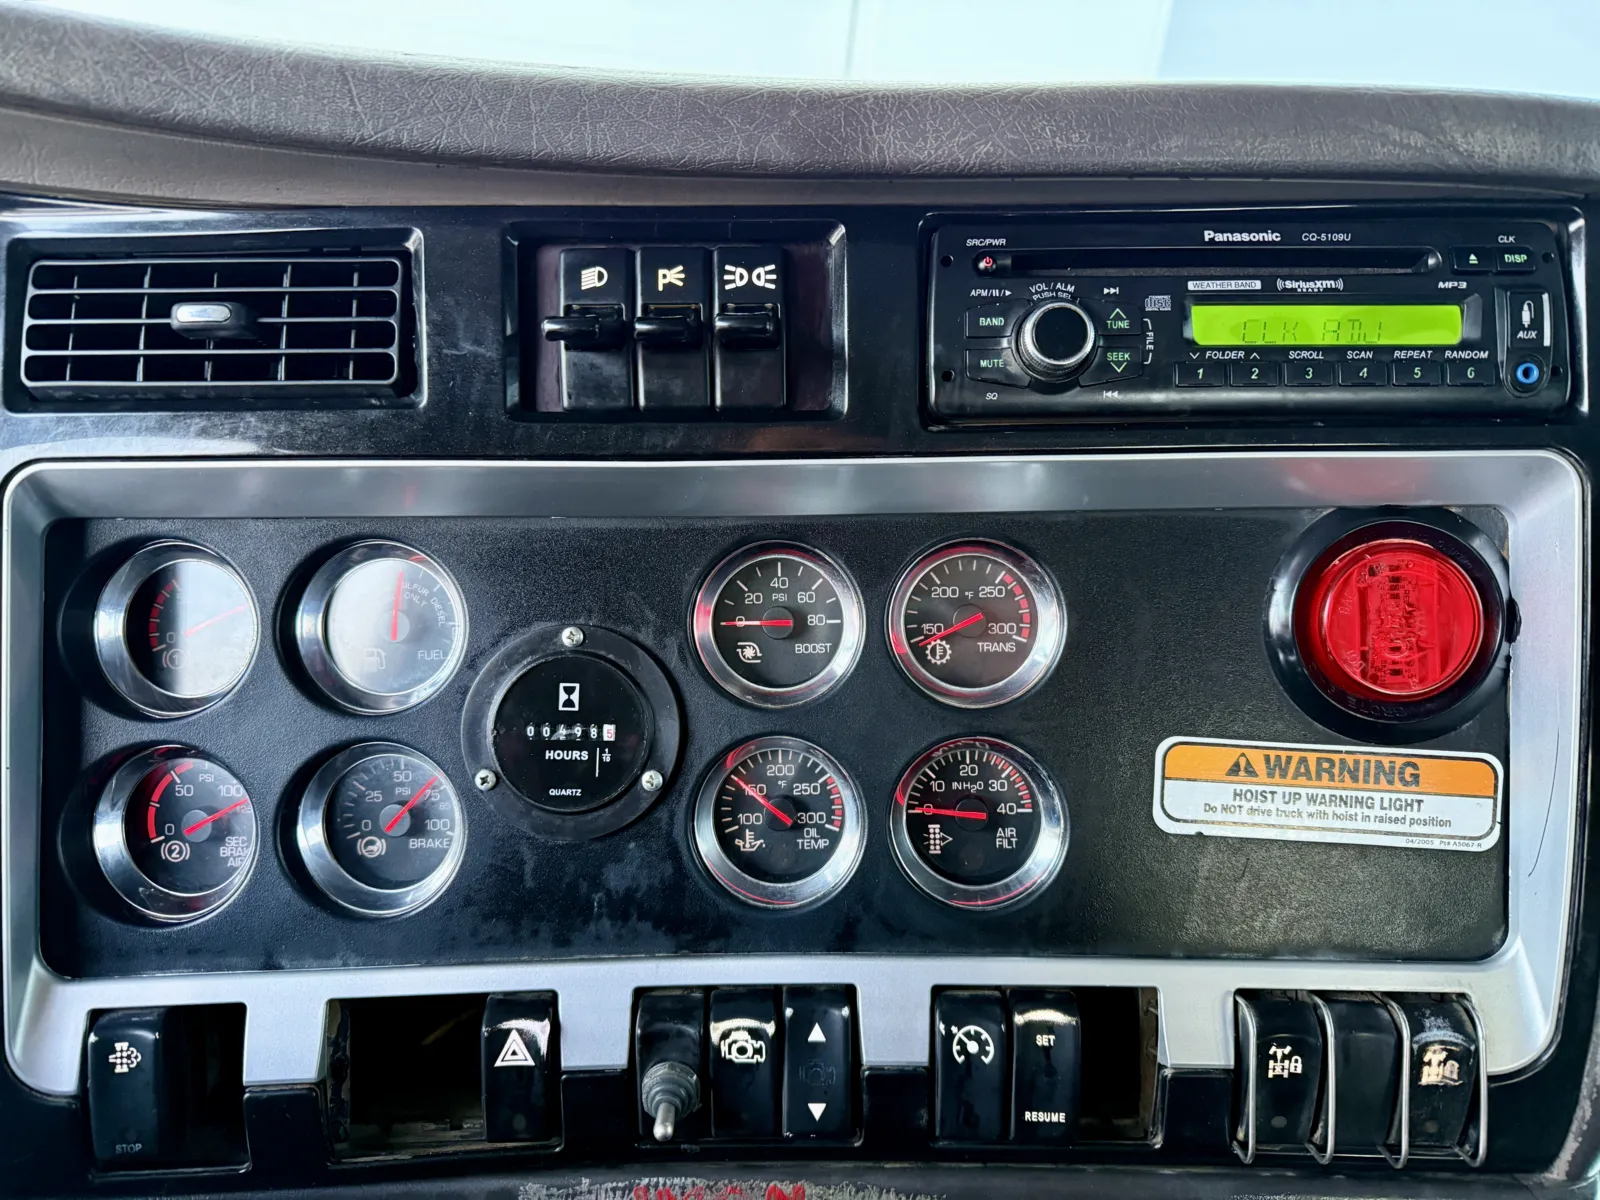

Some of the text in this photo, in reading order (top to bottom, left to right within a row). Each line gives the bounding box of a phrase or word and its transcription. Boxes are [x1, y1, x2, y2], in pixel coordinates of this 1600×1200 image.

[1203, 230, 1281, 242] Panasonic
[1301, 233, 1351, 242] CQ-5109U
[1498, 235, 1515, 244] CLK
[966, 238, 1006, 247] SRC/PWR
[1504, 254, 1527, 264] DISP
[1029, 282, 1048, 293] VOL
[1056, 282, 1075, 293] ALM
[1192, 281, 1257, 289] WEATHER BAND
[1438, 281, 1467, 289] MP3
[1032, 291, 1072, 301] PUSH SEL
[979, 316, 1005, 326] BAND
[1106, 320, 1130, 329] TUNE
[1516, 330, 1537, 339] AUX
[1146, 332, 1154, 350] FILE
[1106, 352, 1131, 361] SEEK
[1205, 351, 1245, 360] FOLDER
[1288, 351, 1324, 360] SCROLL
[1346, 350, 1373, 360] SCAN
[1393, 350, 1433, 360] REPEAT
[1444, 350, 1489, 360] RANDOM
[979, 358, 1005, 369] MUTE
[1197, 367, 1203, 379] 1
[1251, 367, 1259, 379] 2
[1305, 367, 1313, 379] 3
[1359, 367, 1368, 379] 4
[1413, 367, 1422, 379] 5
[1467, 367, 1475, 379] 6
[985, 392, 998, 401] SQ
[770, 577, 789, 588] 40
[772, 593, 788, 601] PSI
[931, 586, 959, 598] 200
[979, 586, 1005, 597] 250
[745, 593, 763, 604] 20
[797, 592, 815, 603] 60
[807, 614, 826, 626] 80
[921, 623, 944, 634] 150
[988, 623, 1016, 634] 300
[166, 632, 175, 643] 0
[795, 643, 832, 653] BOOST
[977, 642, 1016, 652] TRANS
[417, 650, 446, 660] FUEL
[545, 750, 588, 760] HOURS
[767, 764, 795, 776] 200
[960, 765, 978, 776] 20
[1263, 754, 1420, 787] WARNING
[199, 774, 214, 782] PSI
[393, 771, 412, 782] 50
[175, 785, 193, 796] 50
[218, 785, 243, 796] 100
[793, 783, 820, 795] 250
[930, 781, 945, 792] 10
[988, 780, 1007, 791] 30
[365, 791, 383, 802] 25
[424, 789, 440, 801] 75
[549, 788, 582, 796] QUARTZ
[1233, 788, 1424, 813] HOIST UP WARNING LIGHT
[997, 803, 1016, 814] 40
[737, 813, 762, 825] 100
[797, 812, 826, 824] 300
[1204, 803, 1452, 828] Do NOT drive truck with hoist in raised position
[165, 824, 175, 835] 0
[362, 820, 371, 831] 0
[425, 819, 450, 830] 100
[804, 828, 820, 838] OIL
[996, 827, 1016, 838] AIR
[225, 837, 248, 846] SEC
[409, 838, 450, 849] BRAKE
[797, 839, 829, 849] TEMP
[996, 838, 1018, 848] FILT
[1036, 1035, 1055, 1047] SET
[1025, 1110, 1066, 1123] RESUME
[115, 1143, 142, 1154] STOP
